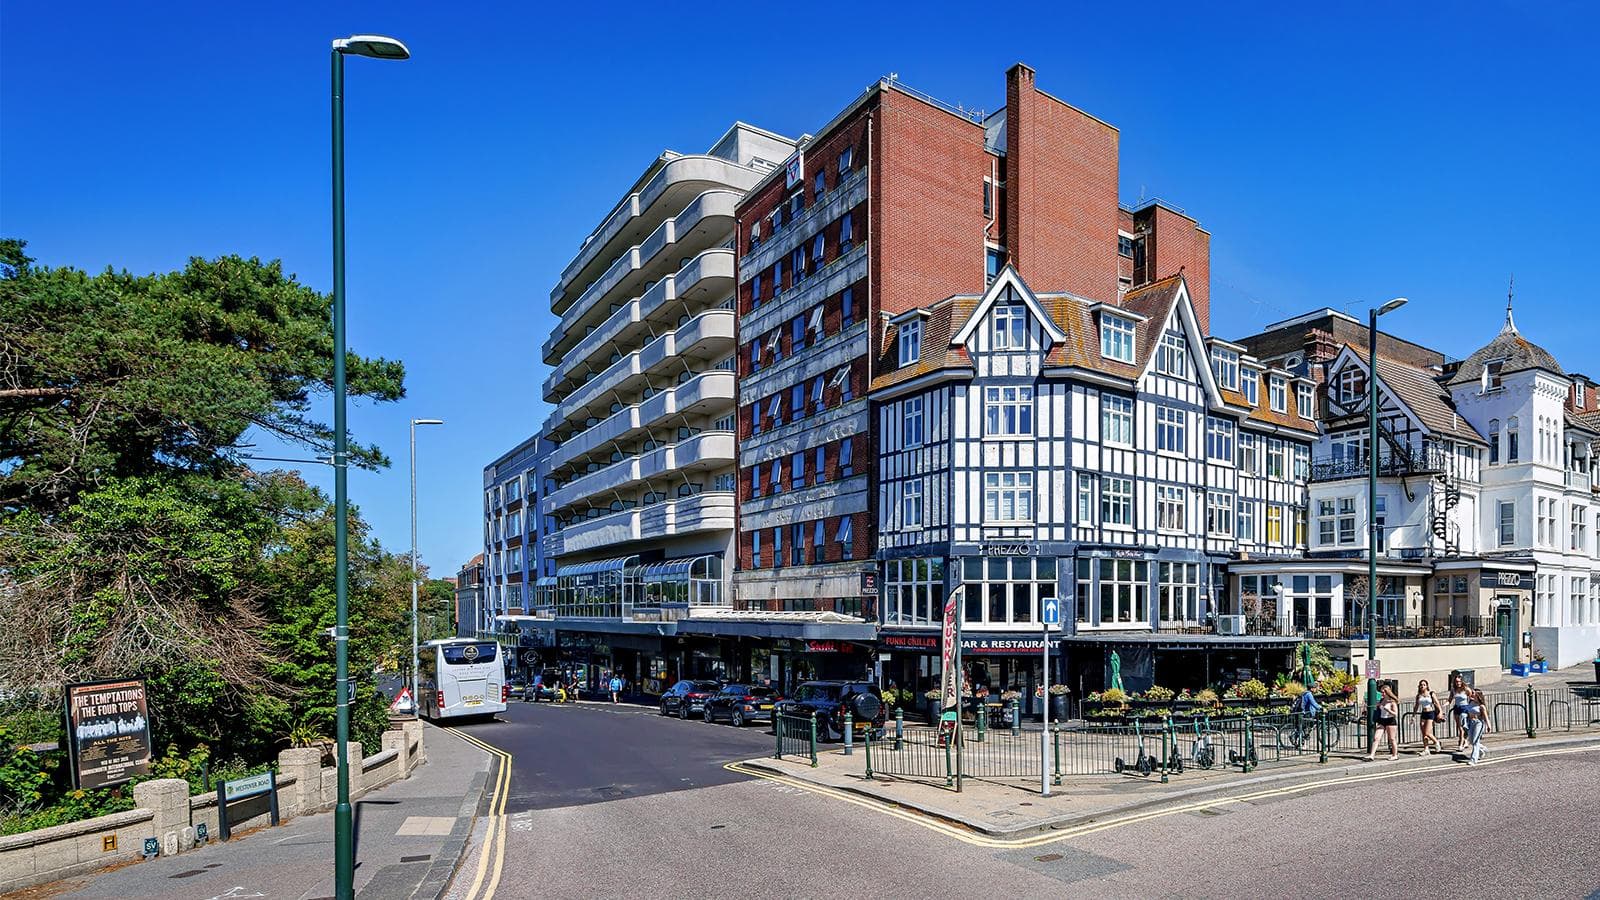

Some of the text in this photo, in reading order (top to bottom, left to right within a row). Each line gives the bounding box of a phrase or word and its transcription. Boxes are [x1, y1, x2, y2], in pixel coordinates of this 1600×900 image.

[988, 544, 1030, 555] PREZZO
[1498, 572, 1520, 585] PREZZO
[885, 636, 906, 646] FUNKI
[980, 640, 988, 648] &
[991, 640, 1061, 649] RESTAURANT
[73, 688, 143, 708] THE TEMPTATIONS
[81, 701, 138, 718] THE FOUR TOPS
[104, 834, 115, 850] H
[146, 842, 156, 851] SV
